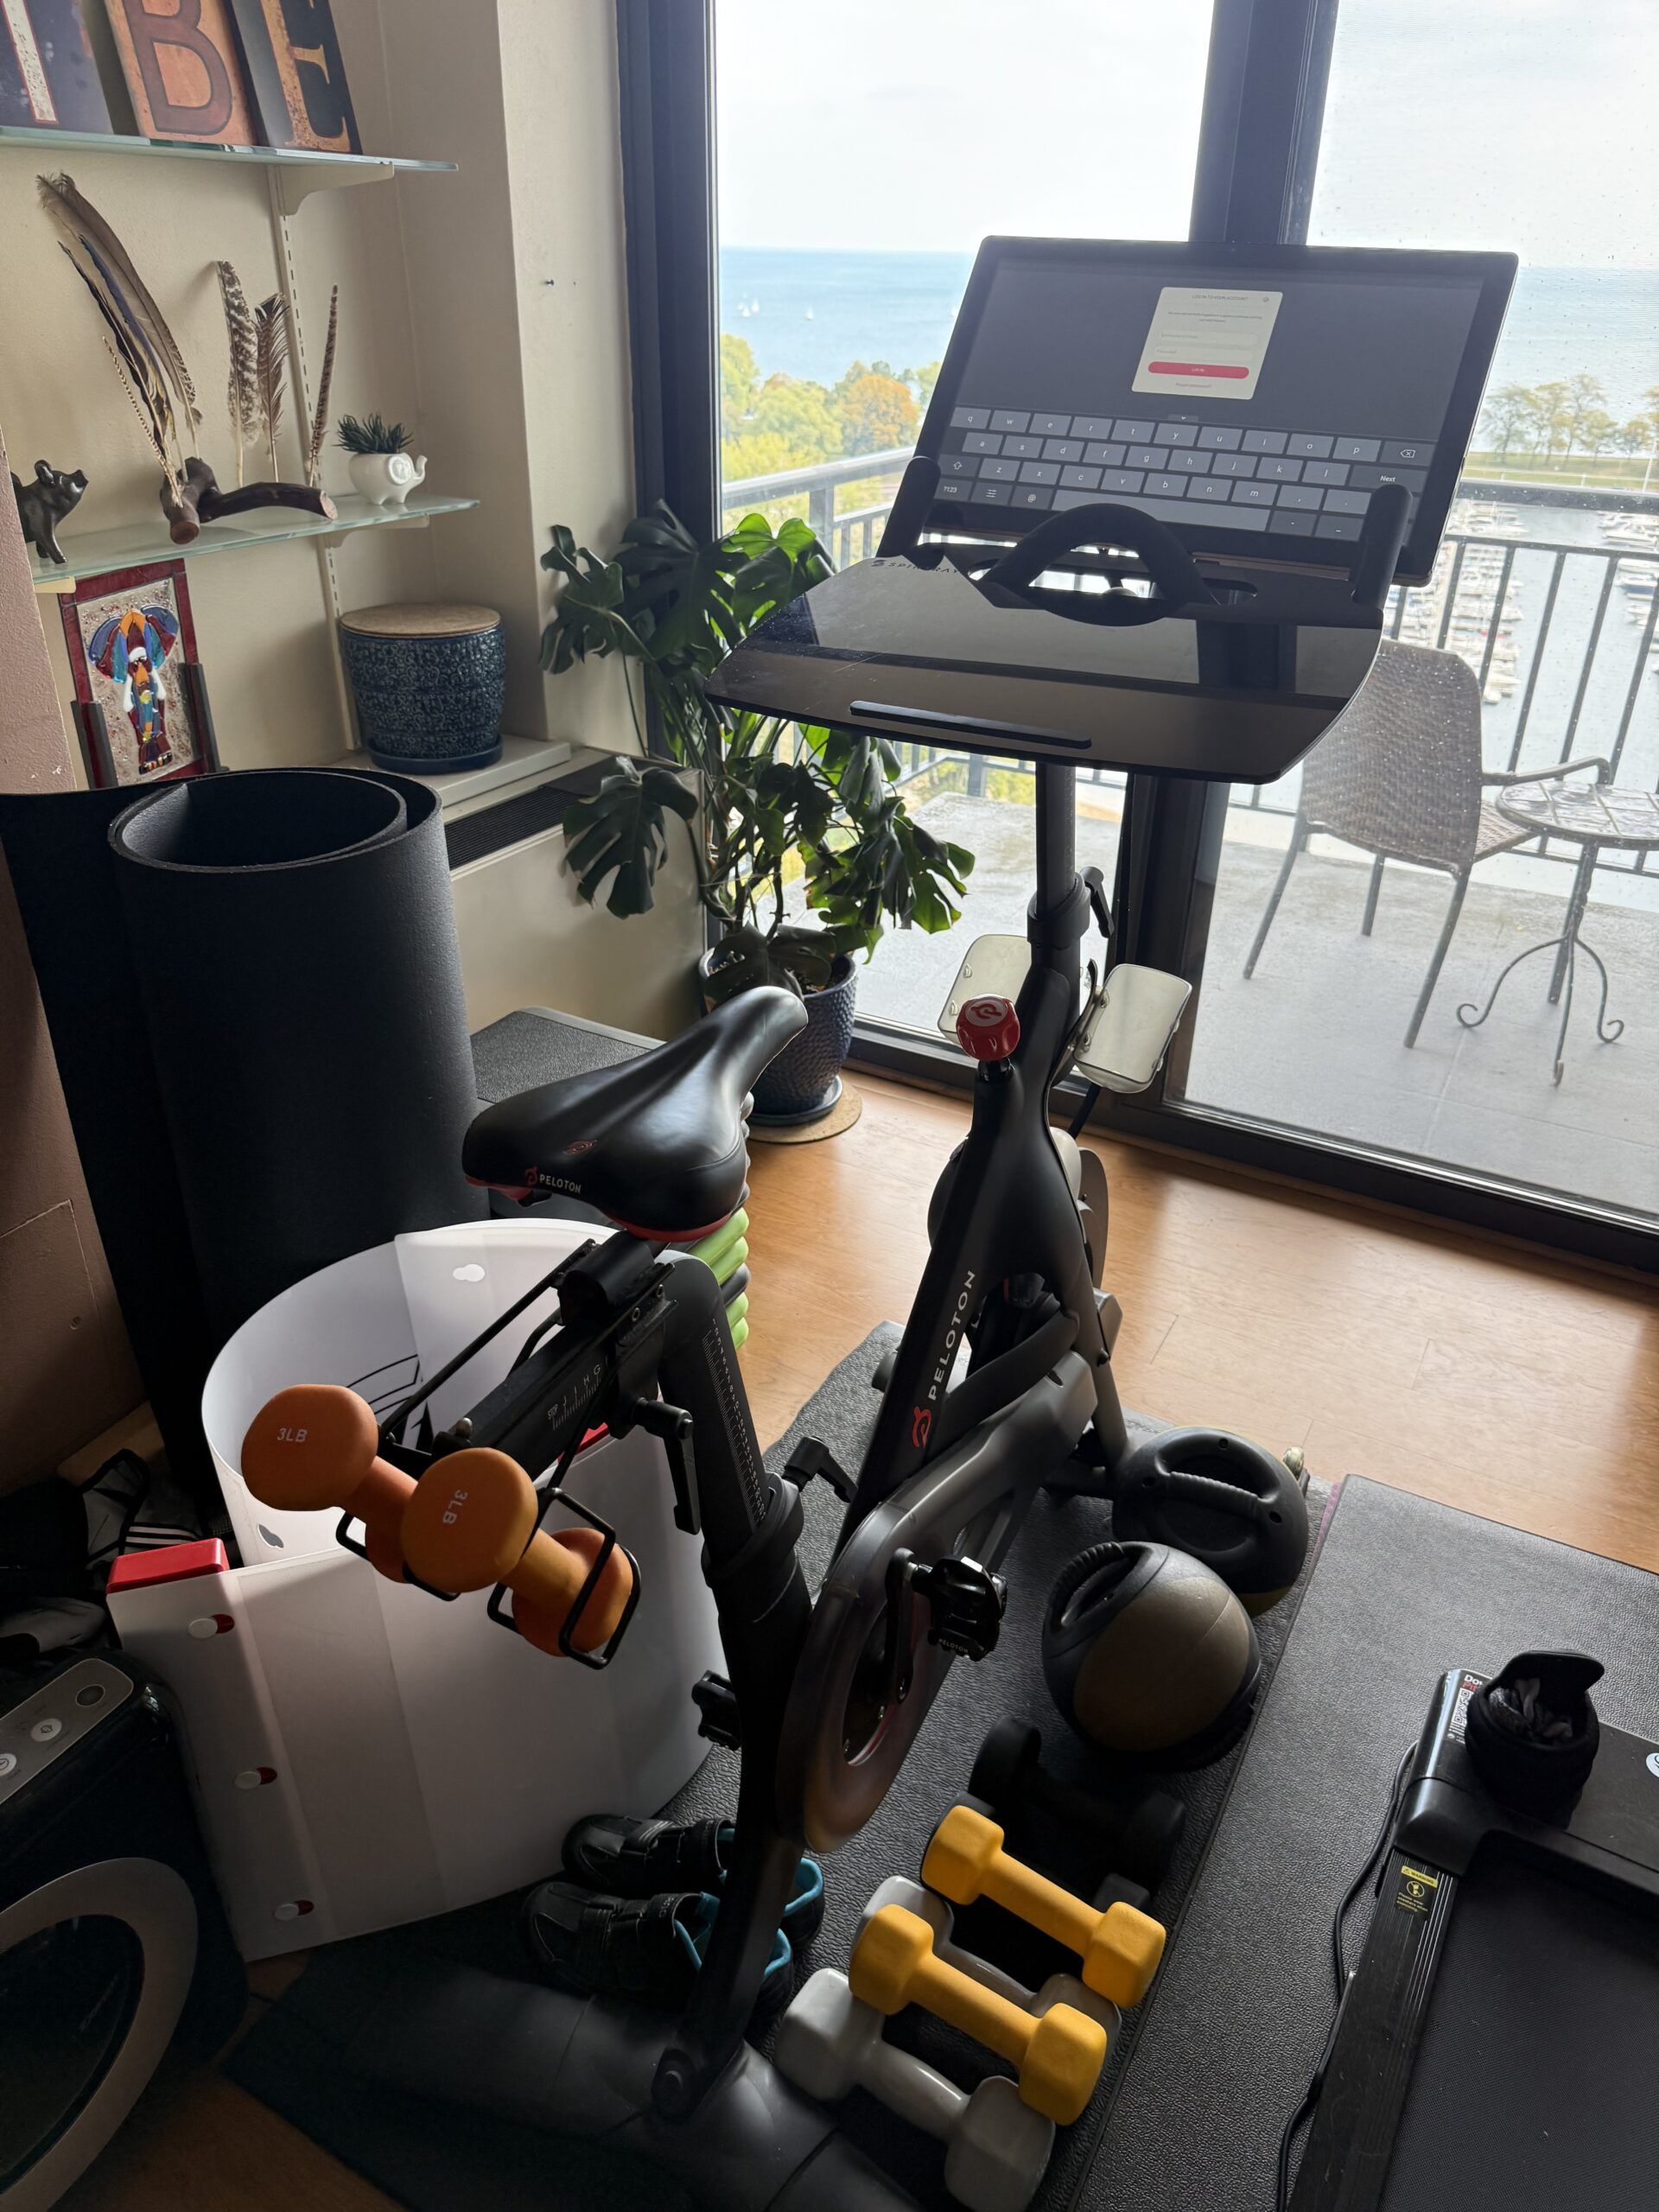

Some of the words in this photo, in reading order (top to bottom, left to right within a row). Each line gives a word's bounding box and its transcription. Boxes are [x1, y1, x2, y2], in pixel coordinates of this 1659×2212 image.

[124, 0, 232, 136] B
[1380, 474, 1396, 483] Next
[539, 1173, 582, 1193] PELOTON
[928, 1270, 976, 1401] PELOTON
[593, 1364, 601, 1376] G
[583, 1374, 590, 1386] H
[276, 1427, 308, 1442] 3LB
[442, 1489, 468, 1524] 3LB
